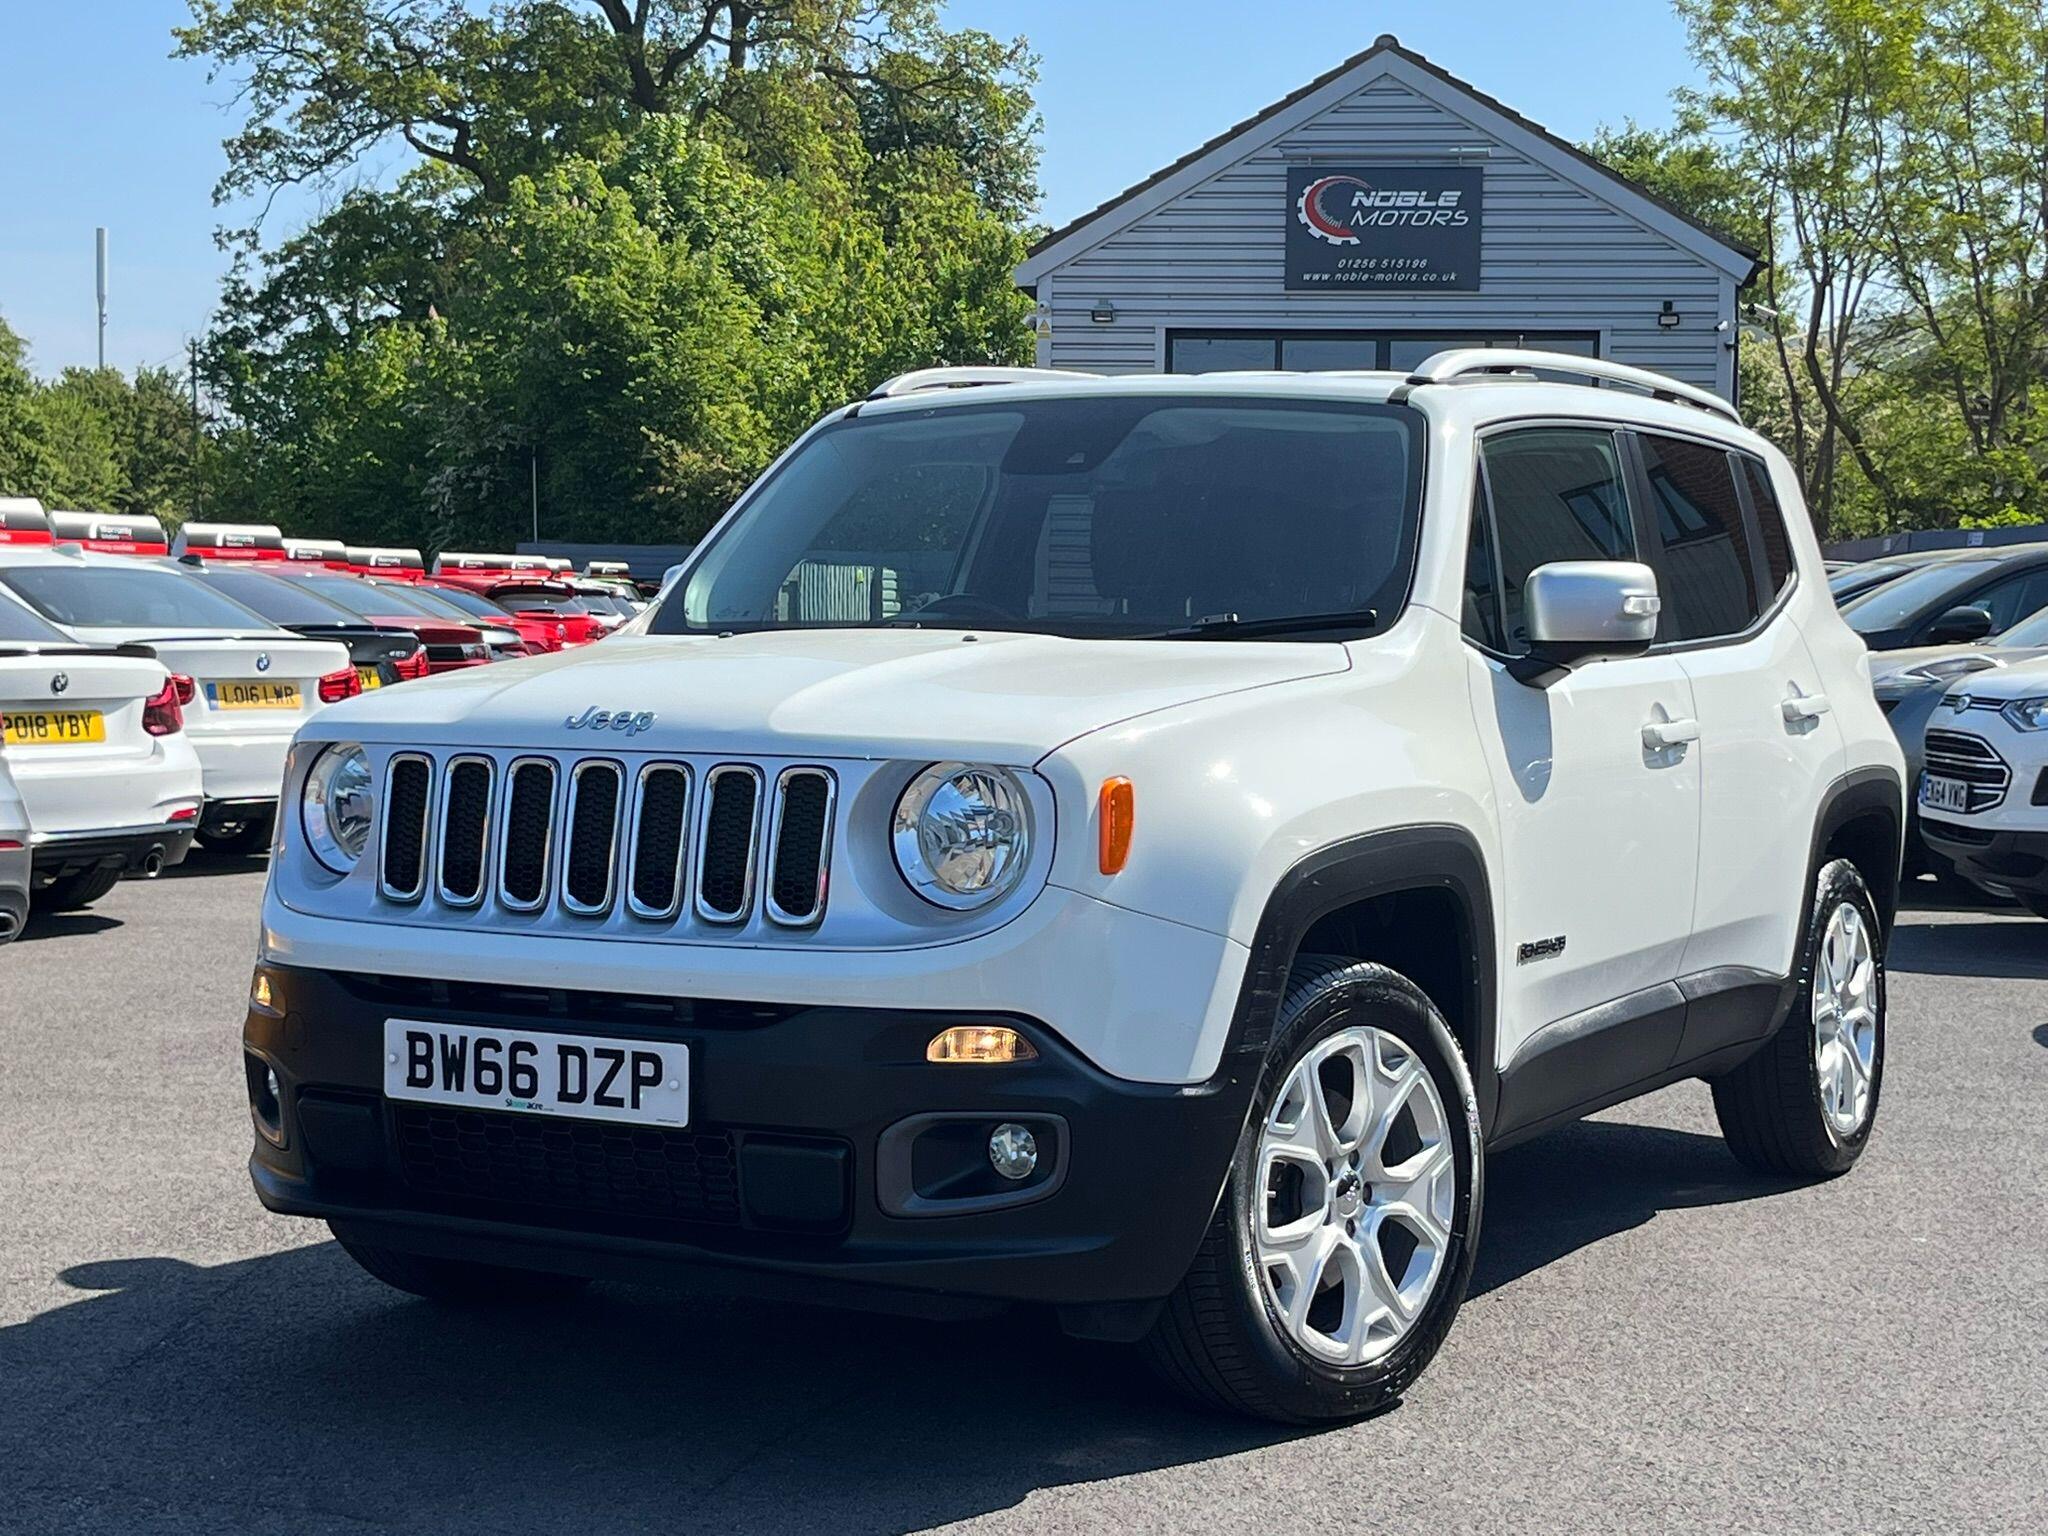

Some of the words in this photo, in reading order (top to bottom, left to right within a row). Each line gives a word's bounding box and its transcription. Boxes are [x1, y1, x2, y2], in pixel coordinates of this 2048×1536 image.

[1351, 191, 1462, 207] NOBLE
[1350, 210, 1470, 226] MOTORS
[1337, 258, 1377, 269] 01256
[1303, 270, 1457, 282] www.noble-motors.co.uk
[53, 714, 91, 738] VBY
[565, 705, 657, 737] Jeep
[405, 1030, 539, 1100] BW66
[557, 1044, 663, 1110] DZP
